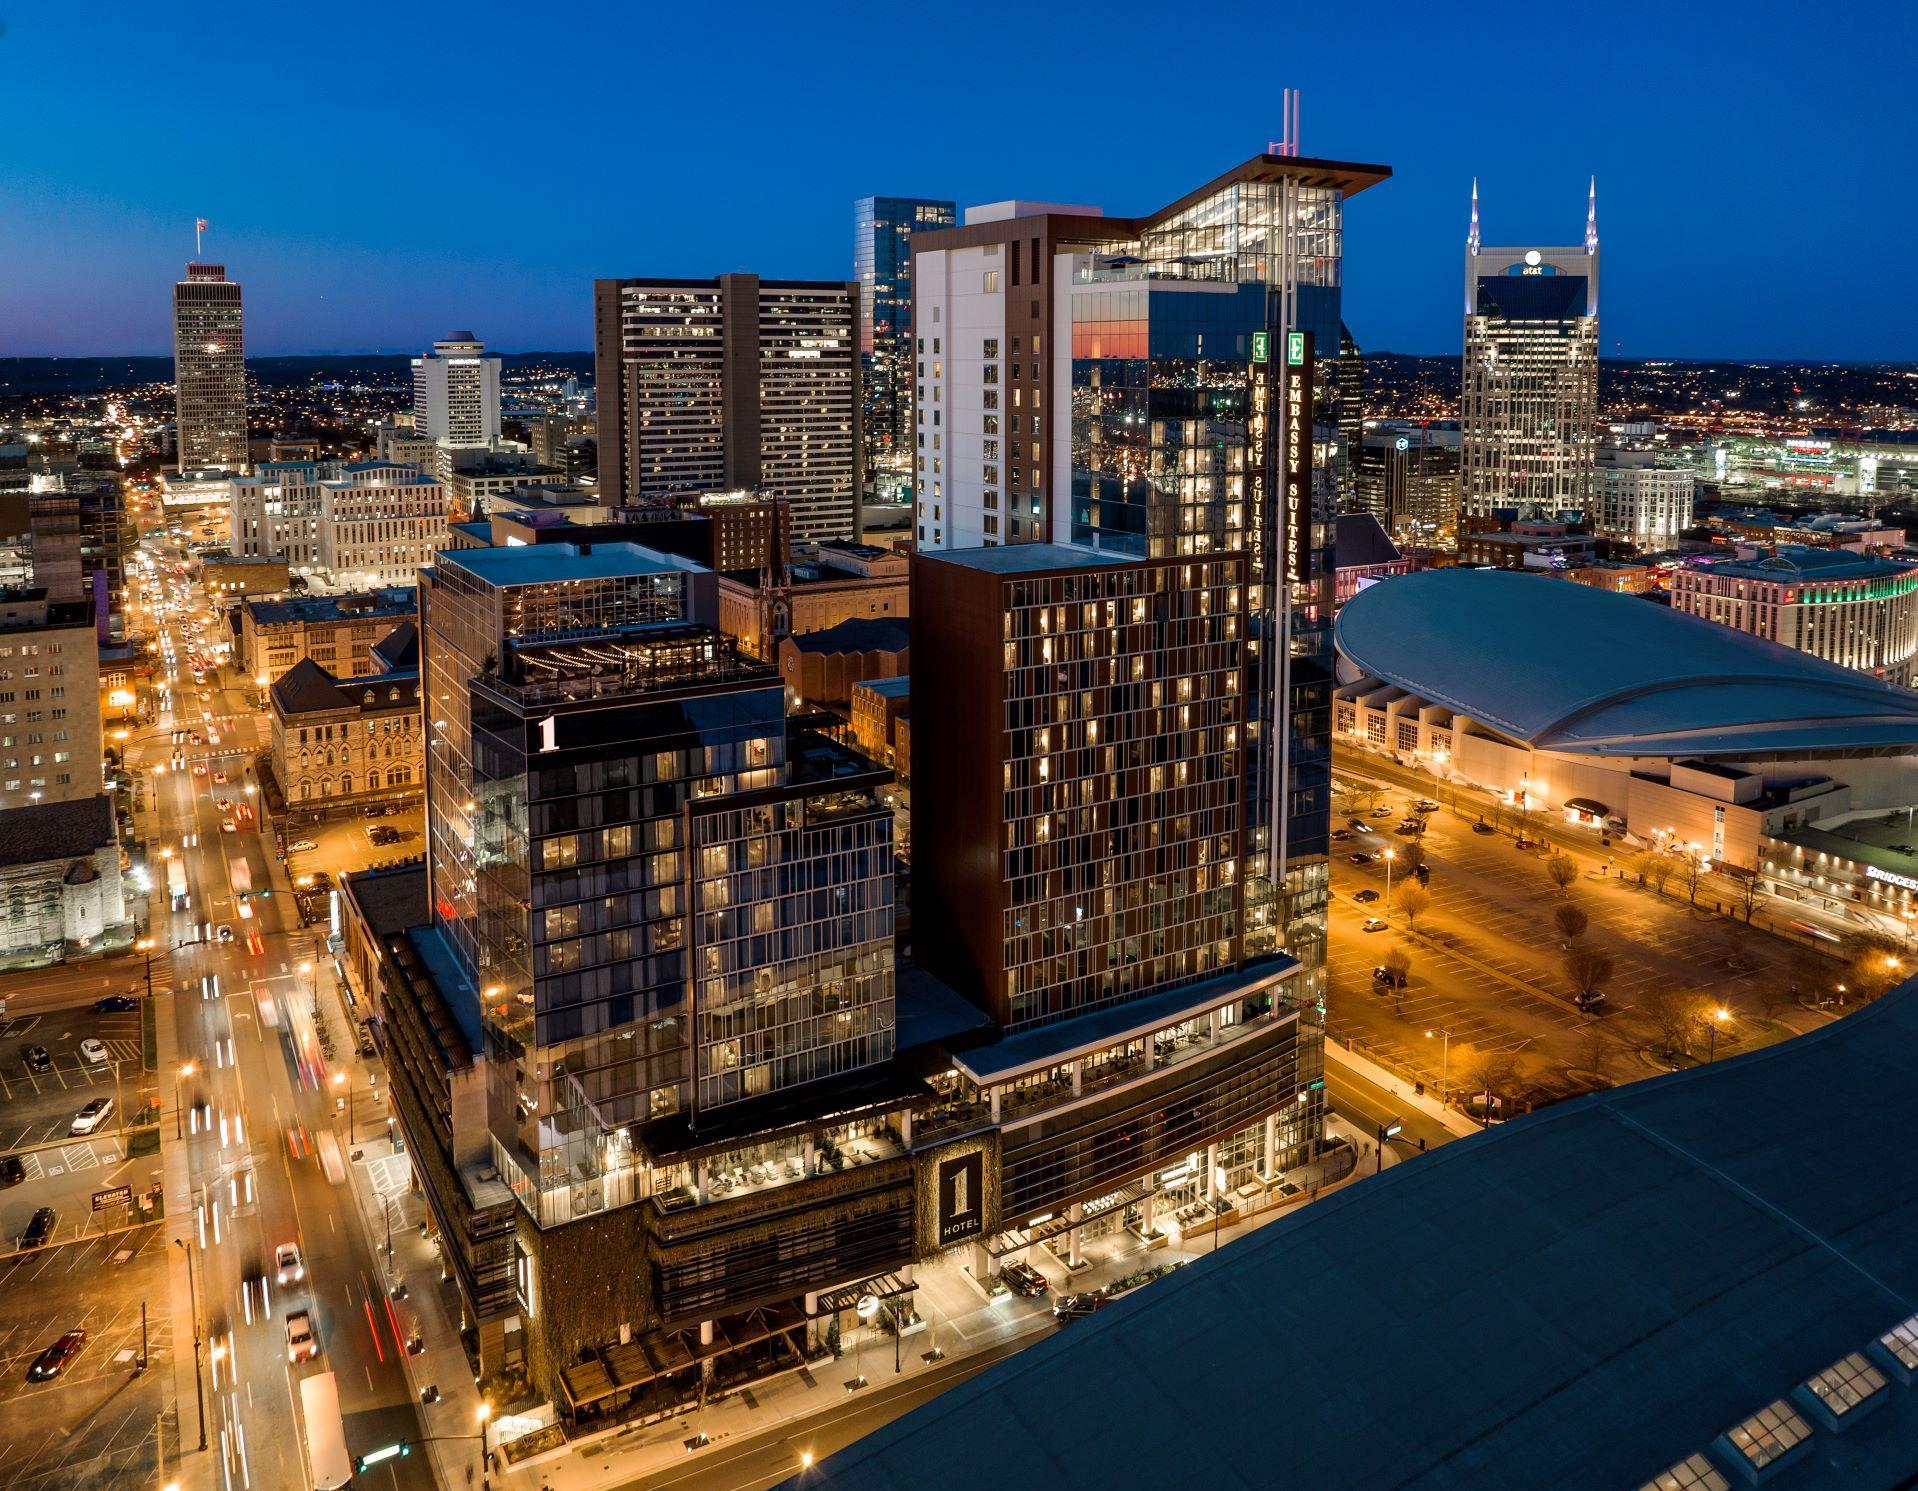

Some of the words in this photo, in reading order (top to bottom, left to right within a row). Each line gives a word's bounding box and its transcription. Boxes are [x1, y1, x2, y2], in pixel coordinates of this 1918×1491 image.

[1289, 375, 1302, 473] EMBASSY
[1288, 483, 1299, 566] SUITES
[538, 715, 560, 752] 1
[1865, 865, 1918, 891] BRIDGES
[949, 1166, 973, 1218] 1
[944, 1218, 980, 1237] HOTEL
